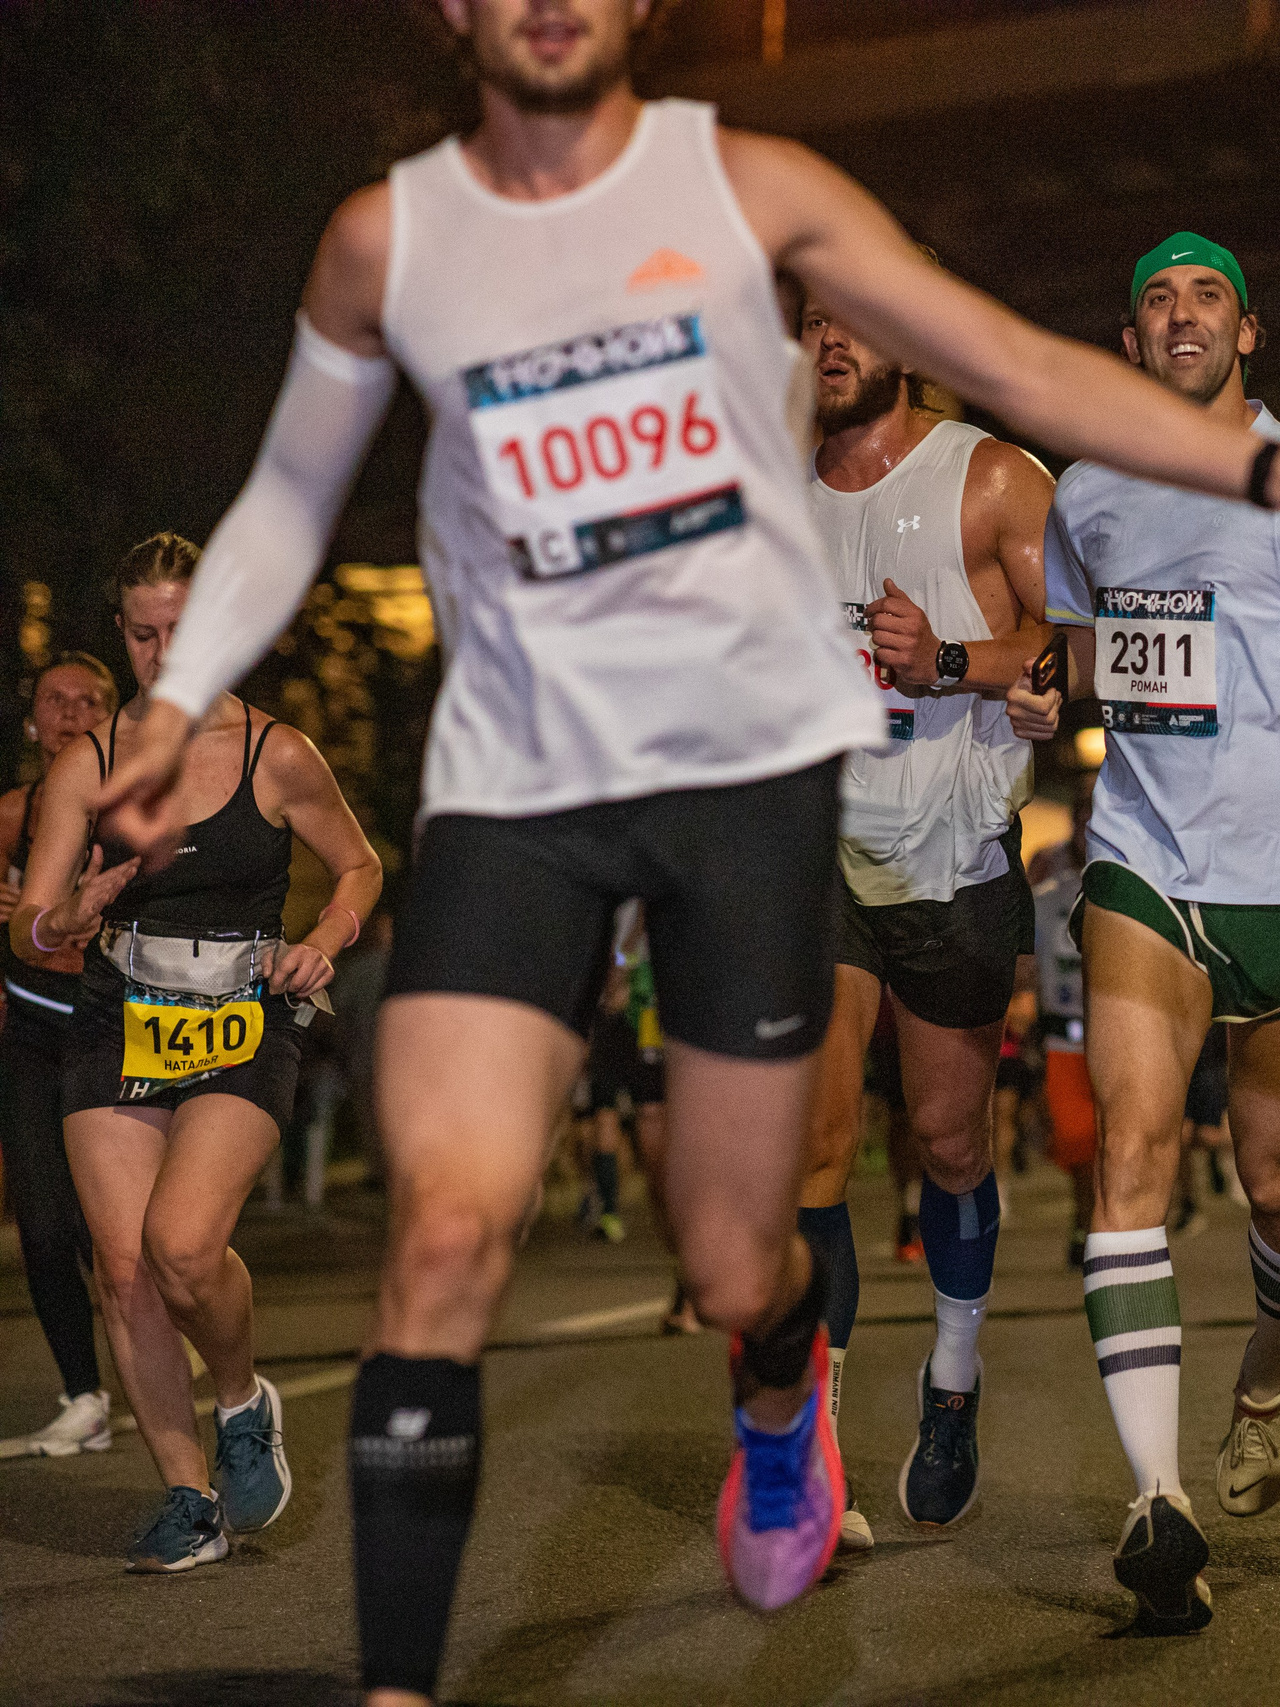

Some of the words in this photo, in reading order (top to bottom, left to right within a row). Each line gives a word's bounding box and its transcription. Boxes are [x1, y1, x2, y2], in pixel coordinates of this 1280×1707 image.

[498, 390, 720, 501] 10096
[1104, 587, 1205, 614] НОЧНОЙ
[1110, 631, 1192, 677] 2311
[1130, 680, 1168, 693] РОМАН
[175, 846, 198, 855] ORIA
[144, 1014, 247, 1056] 1410
[164, 1055, 219, 1071] НАТАЛЬЯ
